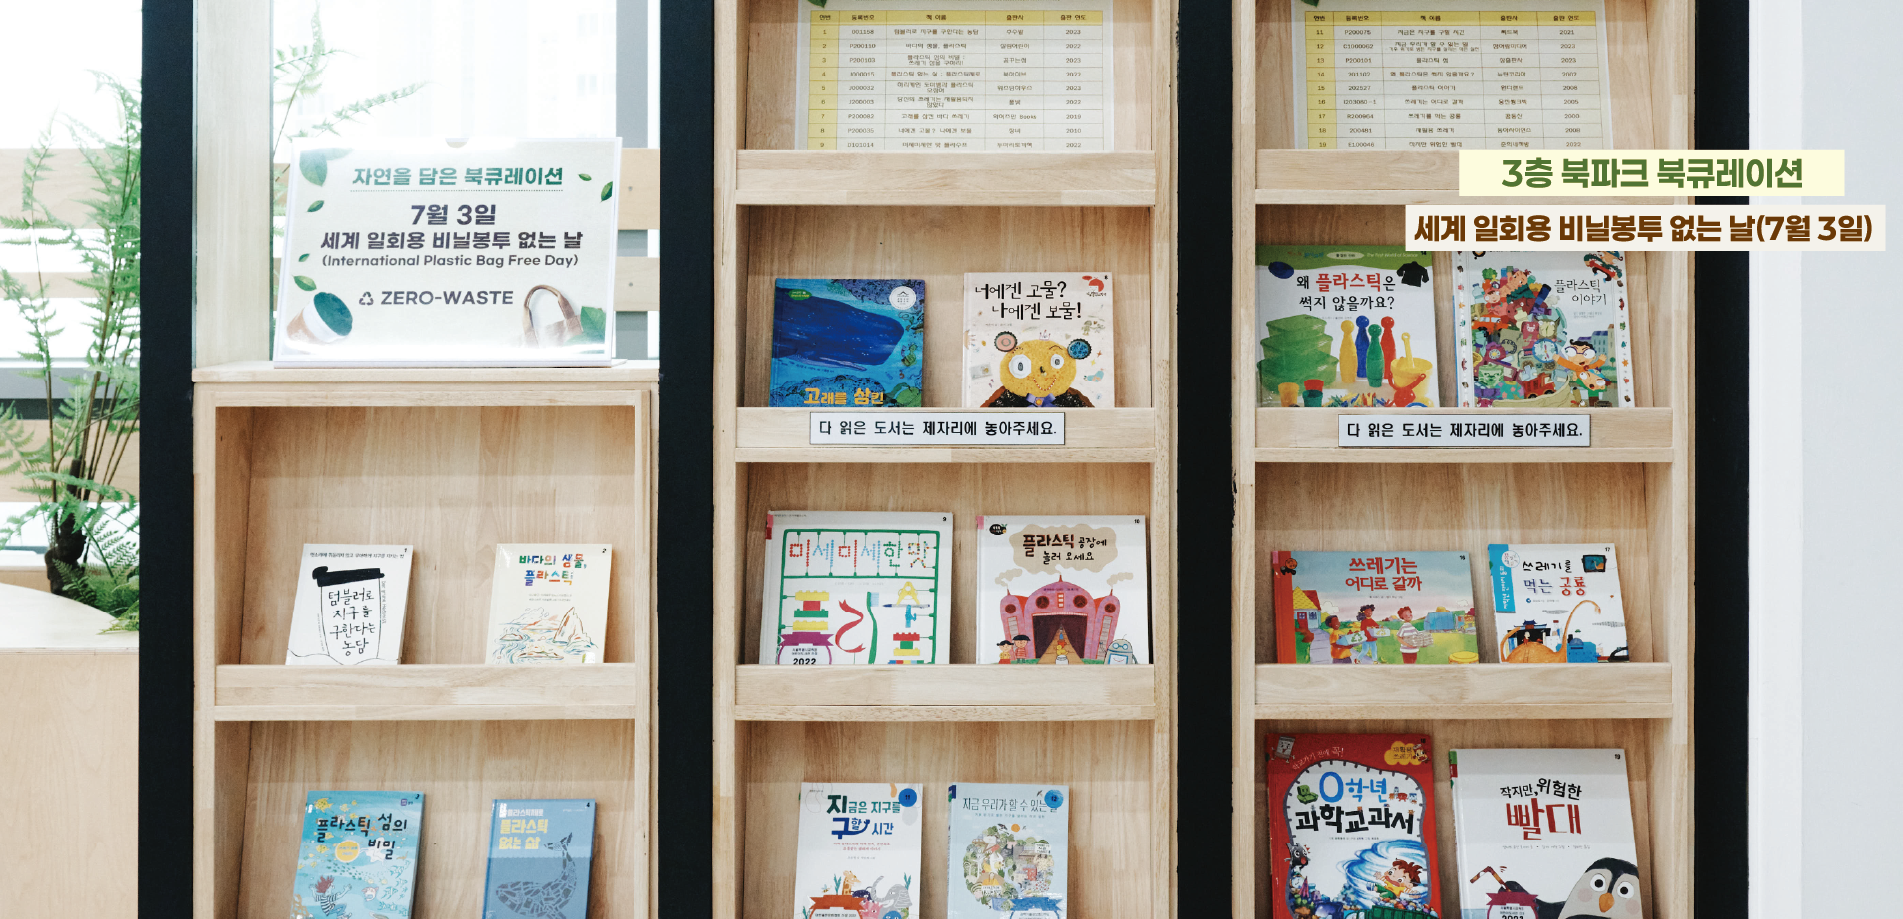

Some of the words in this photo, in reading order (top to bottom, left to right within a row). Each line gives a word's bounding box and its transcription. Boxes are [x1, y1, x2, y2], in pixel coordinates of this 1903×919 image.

[353, 167, 412, 186] 자연을
[419, 167, 457, 186] 담은
[465, 167, 563, 186] 북큐레이션
[411, 204, 449, 226] 7월
[456, 204, 497, 226] 3일
[321, 232, 359, 250] 세계
[367, 232, 425, 250] 일회용
[433, 232, 511, 250] 비닐봉투
[518, 232, 556, 250] 없는
[564, 232, 583, 250] 날
[322, 254, 420, 268] (International
[425, 254, 472, 266] Plastic
[477, 255, 504, 268] Bag
[509, 255, 540, 266] Free
[545, 254, 578, 268] Day)
[976, 282, 1021, 299] 너에겐
[1027, 281, 1067, 299] 고물?
[1297, 276, 1309, 289] 왜
[1316, 273, 1395, 292] 플라스틱은
[1555, 279, 1600, 293] 플라스틱
[381, 291, 513, 305] ZERO-WASTE
[1300, 297, 1326, 311] 썩지
[1333, 296, 1395, 311] 않을까요?
[1572, 294, 1607, 305] 이야기
[993, 302, 1040, 320] 나에겐
[1046, 302, 1081, 320] 보물!
[804, 388, 847, 404] 고래를
[854, 388, 883, 404] 삼킨
[819, 421, 831, 435] 다
[840, 420, 866, 435] 읽은
[875, 421, 915, 435] 도서는
[923, 420, 977, 435] 제자리에
[985, 420, 1057, 435] 놓아주세요.
[1348, 423, 1360, 438] 다
[1368, 423, 1394, 438] 읽은
[1403, 423, 1442, 438] 도서는
[1450, 423, 1504, 438] 제자리에
[1513, 423, 1583, 438] 놓아주세요.
[789, 539, 903, 568] 미세미세한
[908, 541, 928, 568] 맛
[1023, 534, 1074, 557] 플라스틱
[1078, 537, 1107, 548] 공장에
[519, 555, 556, 565] 바다의
[1043, 551, 1061, 564] 놀러
[1066, 552, 1094, 560] 오세요
[1349, 557, 1417, 575] 쓰레기는
[1523, 560, 1572, 573] 쓰레기를
[524, 570, 573, 586] 플라스틱
[1345, 576, 1388, 592] 어디로
[1392, 576, 1422, 592] 갈까
[1523, 579, 1552, 594] 먹는
[1560, 577, 1586, 596] 공룡
[329, 588, 374, 606] 텀블러로
[333, 606, 372, 620] 지구를
[330, 622, 375, 639] 구한다는
[342, 638, 369, 656] 농담
[1332, 746, 1343, 757] 꼭!
[1319, 772, 1387, 803] 0학년
[1500, 784, 1538, 798] 작지만,
[1537, 778, 1582, 800] 위험한
[827, 795, 867, 814] 지금은
[871, 801, 900, 813] 지구를
[963, 798, 979, 810] 지금
[982, 799, 1007, 811] 우리가
[1009, 799, 1018, 811] 할
[1020, 799, 1028, 811] 수
[1031, 799, 1047, 812] 있는
[317, 817, 370, 843] 플라스틱
[378, 813, 407, 831] 섬의
[500, 819, 548, 834] 플라스틱
[832, 817, 870, 839] 구할
[872, 823, 894, 835] 시간
[1296, 804, 1413, 834] 과학교과서
[1506, 798, 1581, 840] 빨대
[368, 839, 395, 859] 비밀
[499, 837, 521, 849] 없는
[525, 837, 540, 849] 삶
